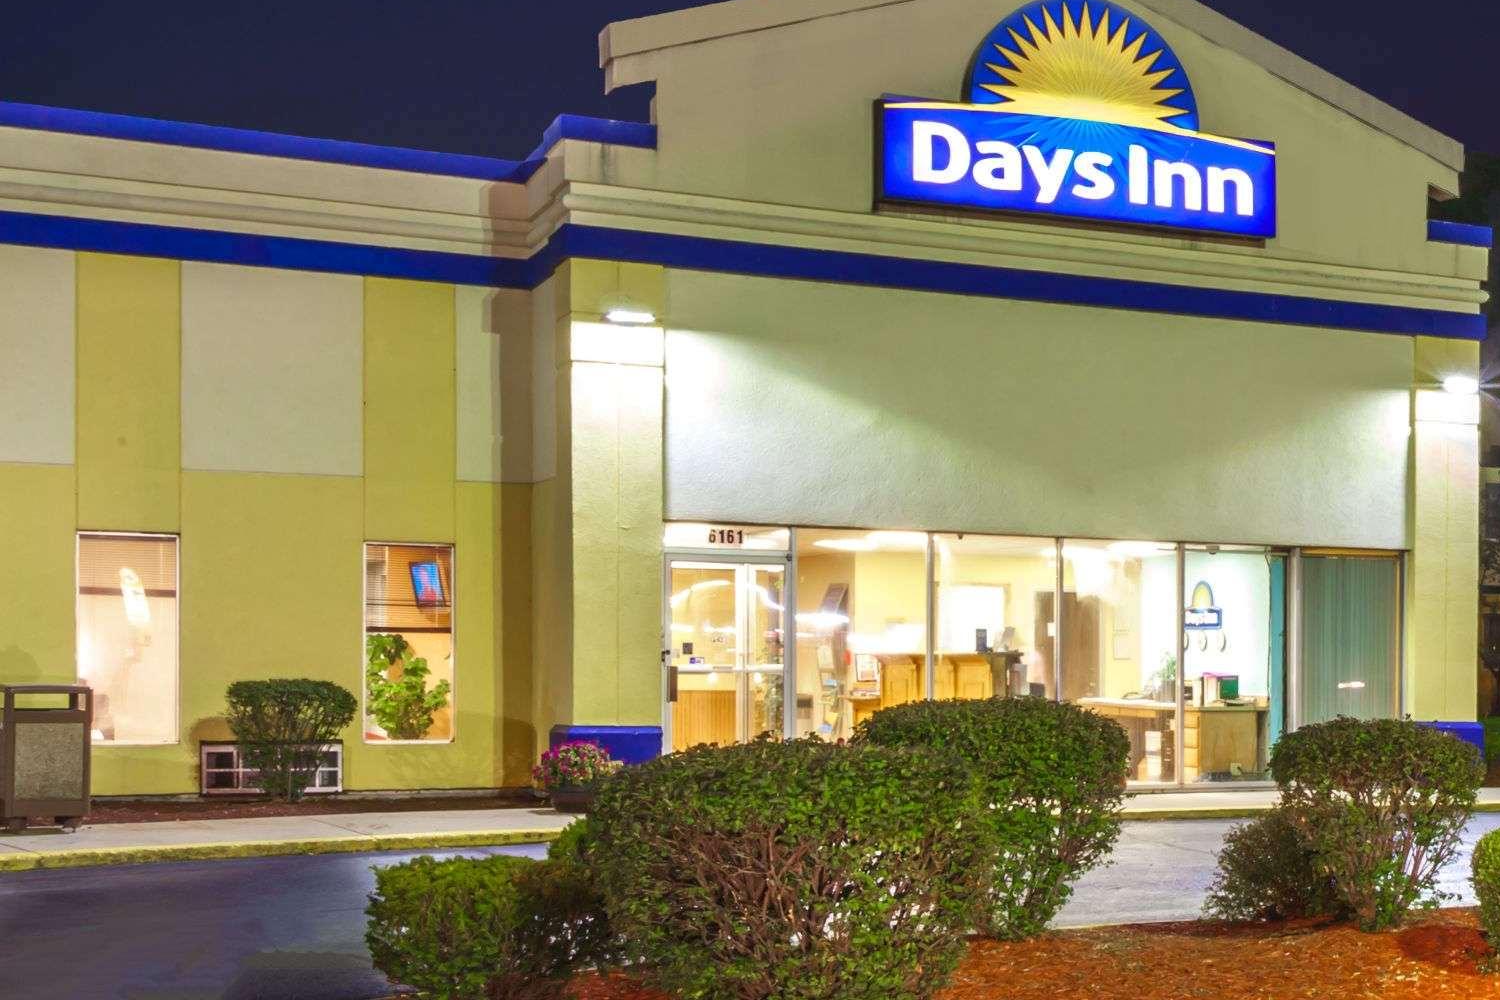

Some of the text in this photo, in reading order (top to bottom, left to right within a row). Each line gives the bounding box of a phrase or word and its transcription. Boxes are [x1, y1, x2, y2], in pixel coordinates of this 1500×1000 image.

[912, 120, 1254, 217] Days Inn
[708, 529, 743, 544] 6161
